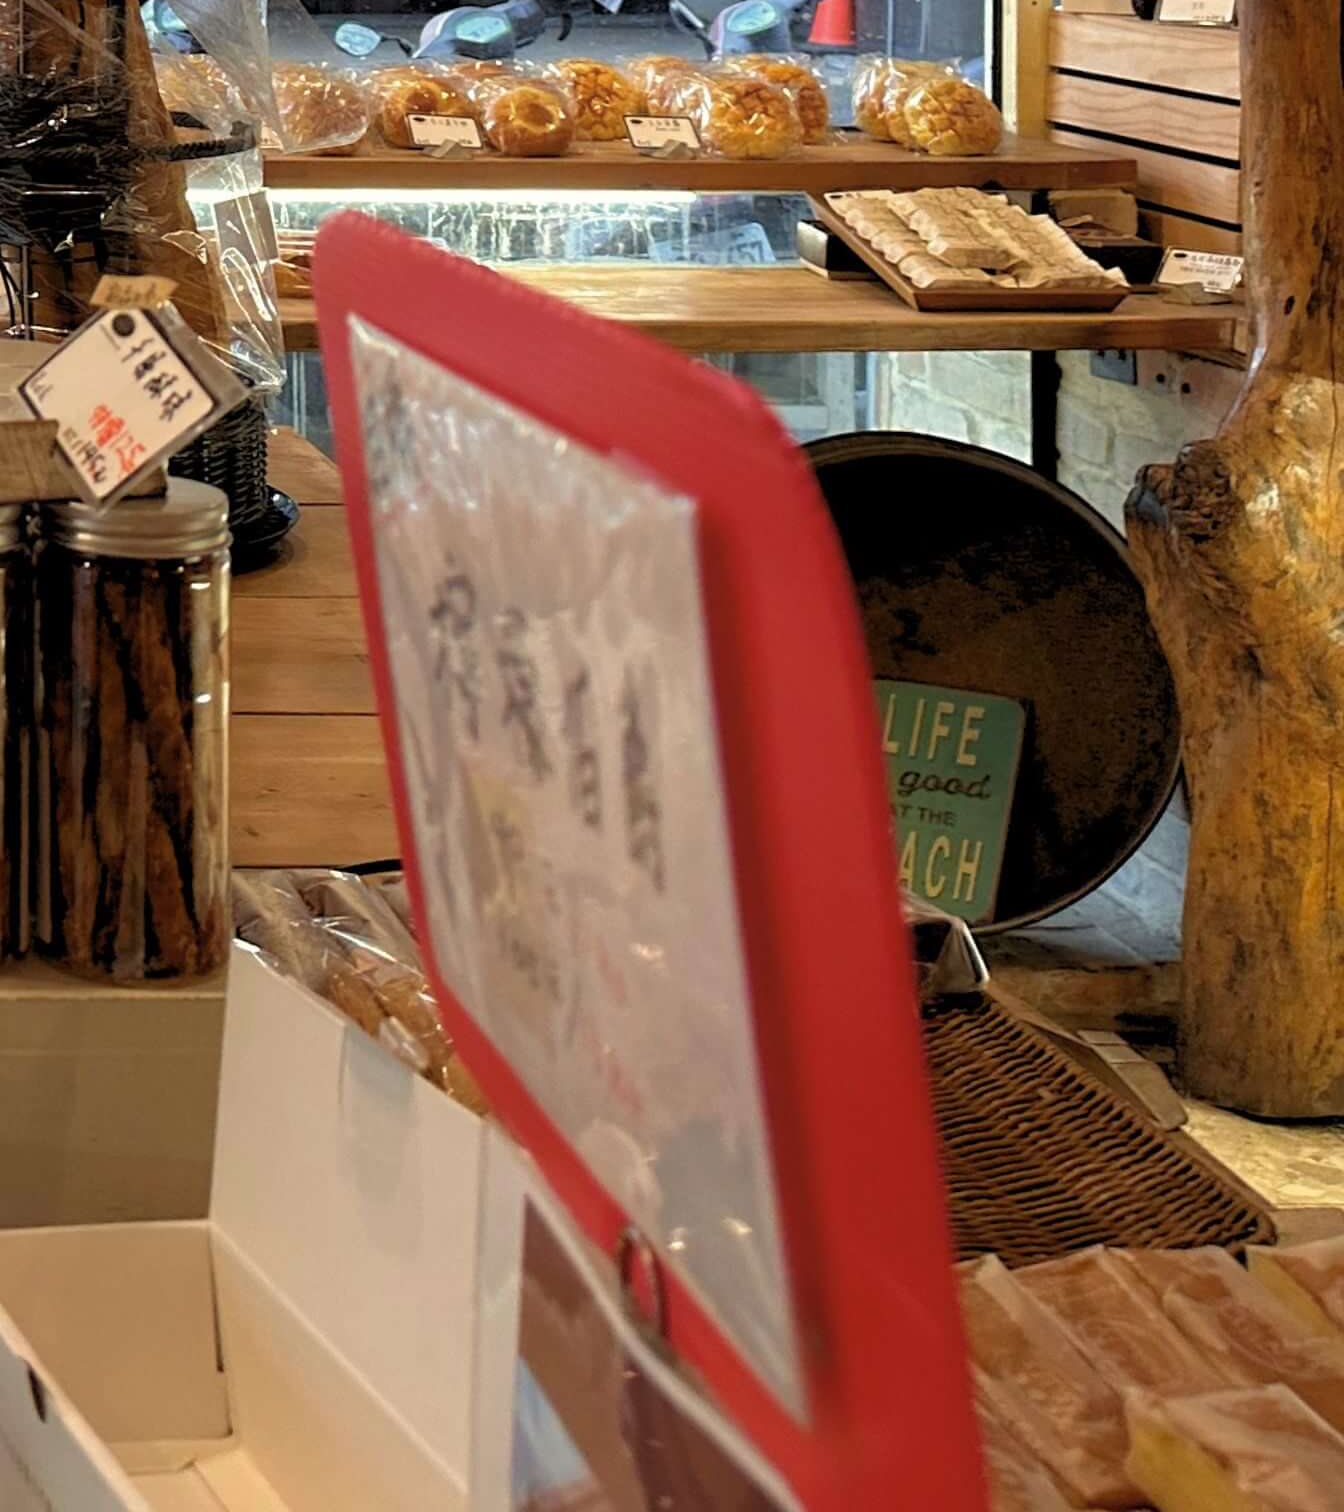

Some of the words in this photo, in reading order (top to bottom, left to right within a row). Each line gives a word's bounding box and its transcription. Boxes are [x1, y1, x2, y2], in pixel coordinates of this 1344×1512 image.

[882, 694, 985, 766] LIFE
[898, 769, 992, 800] good
[917, 807, 957, 827] THE
[898, 831, 983, 903] ACH
